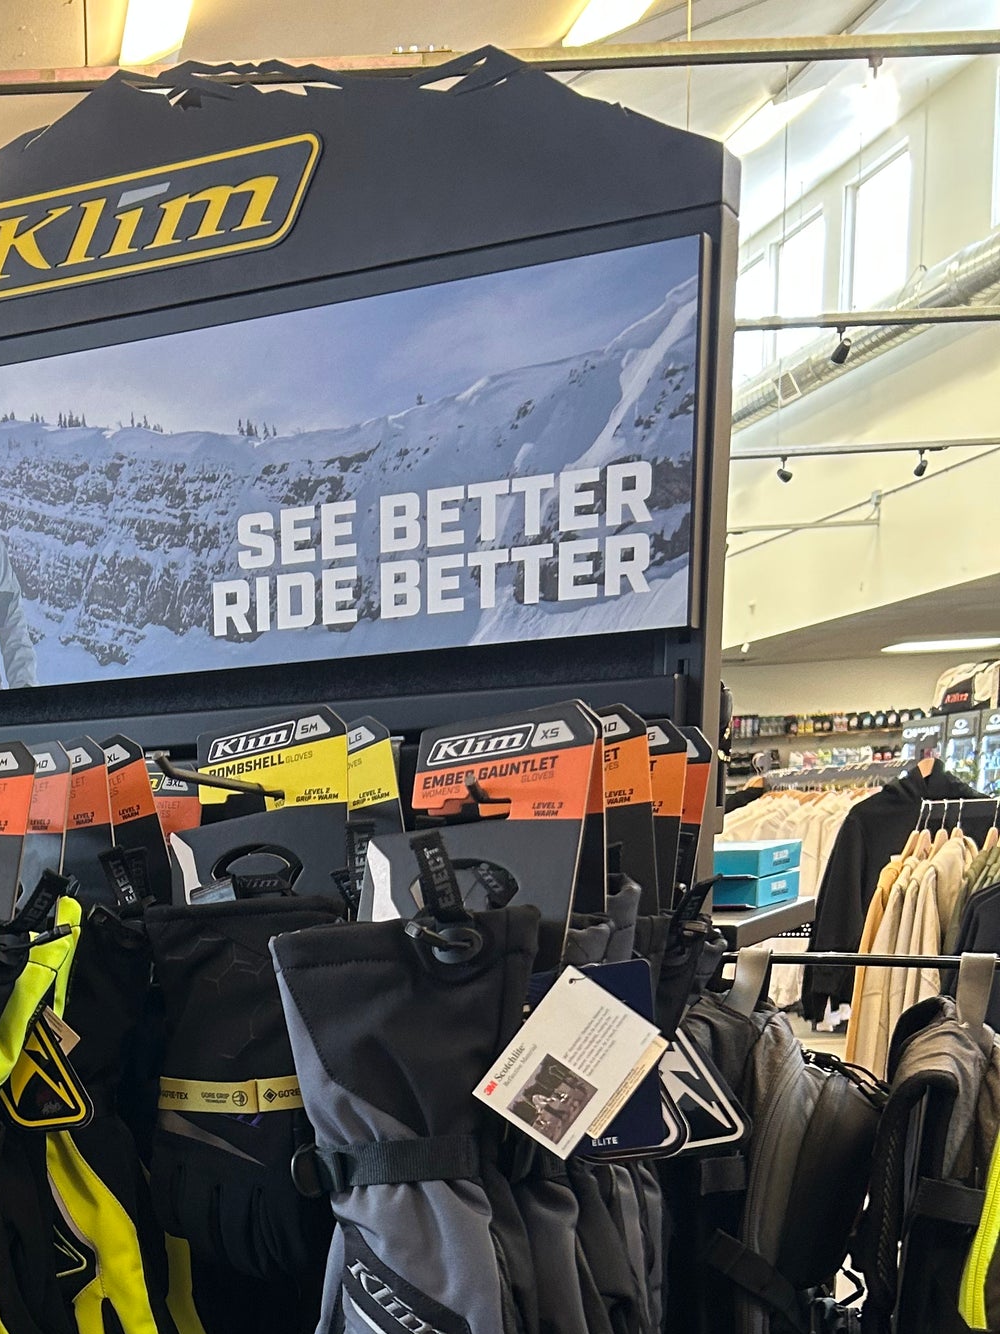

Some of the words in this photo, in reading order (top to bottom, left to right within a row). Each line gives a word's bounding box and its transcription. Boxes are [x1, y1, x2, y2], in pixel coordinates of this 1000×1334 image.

[237, 499, 358, 569] SEE
[378, 462, 652, 552] BETTER
[214, 567, 359, 638] RIDE
[378, 532, 651, 620] BETTER
[540, 727, 560, 740] XS
[107, 752, 120, 763] XL
[286, 751, 313, 764] GLOVES
[478, 756, 558, 780] GAUNTLET
[521, 772, 554, 783] GLOVES
[317, 793, 338, 801] WARM
[607, 796, 630, 804] WARM
[532, 801, 557, 810] LEVEL
[73, 813, 88, 821] LEVEL
[118, 808, 134, 816] LEVEL
[483, 1080, 499, 1096] 3M
[494, 1045, 525, 1082] Scotchlite
[592, 1137, 619, 1147] ELITE
